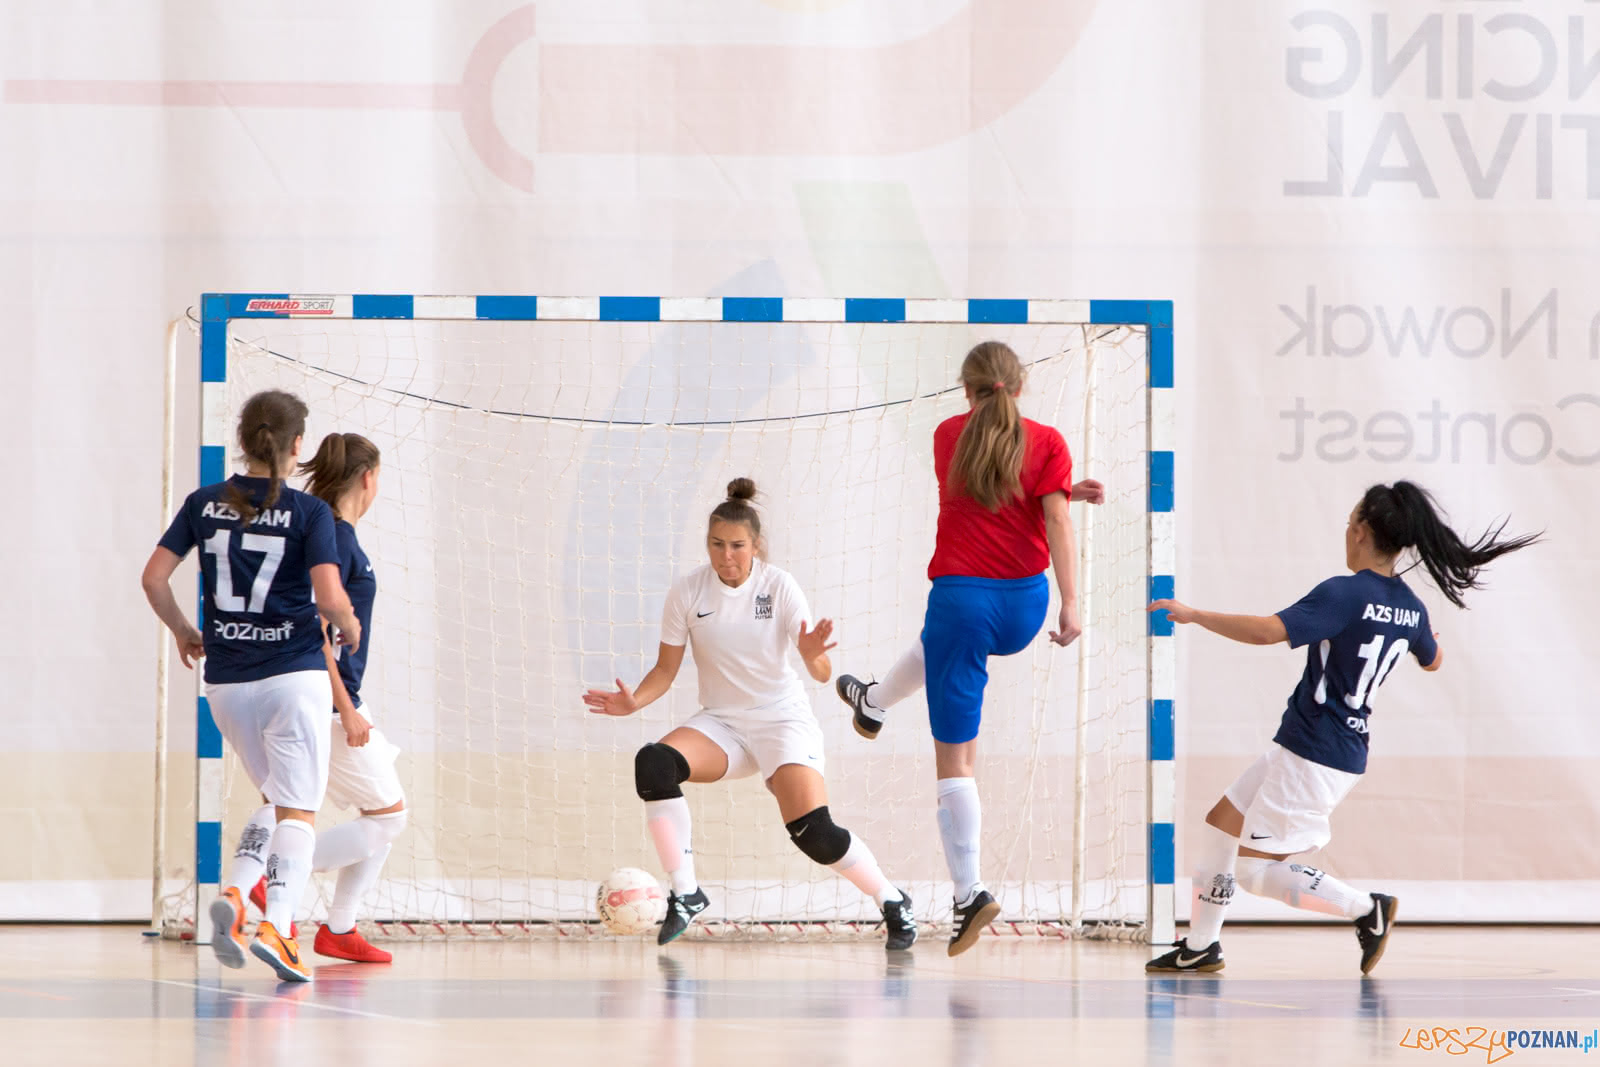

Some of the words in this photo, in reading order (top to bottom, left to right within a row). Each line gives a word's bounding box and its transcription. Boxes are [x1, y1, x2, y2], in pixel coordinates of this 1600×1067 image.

[249, 301, 300, 309] ERHARD
[303, 301, 330, 309] SPORT
[204, 529, 286, 613] 17
[1362, 603, 1392, 623] AZS
[1394, 608, 1420, 628] UAM
